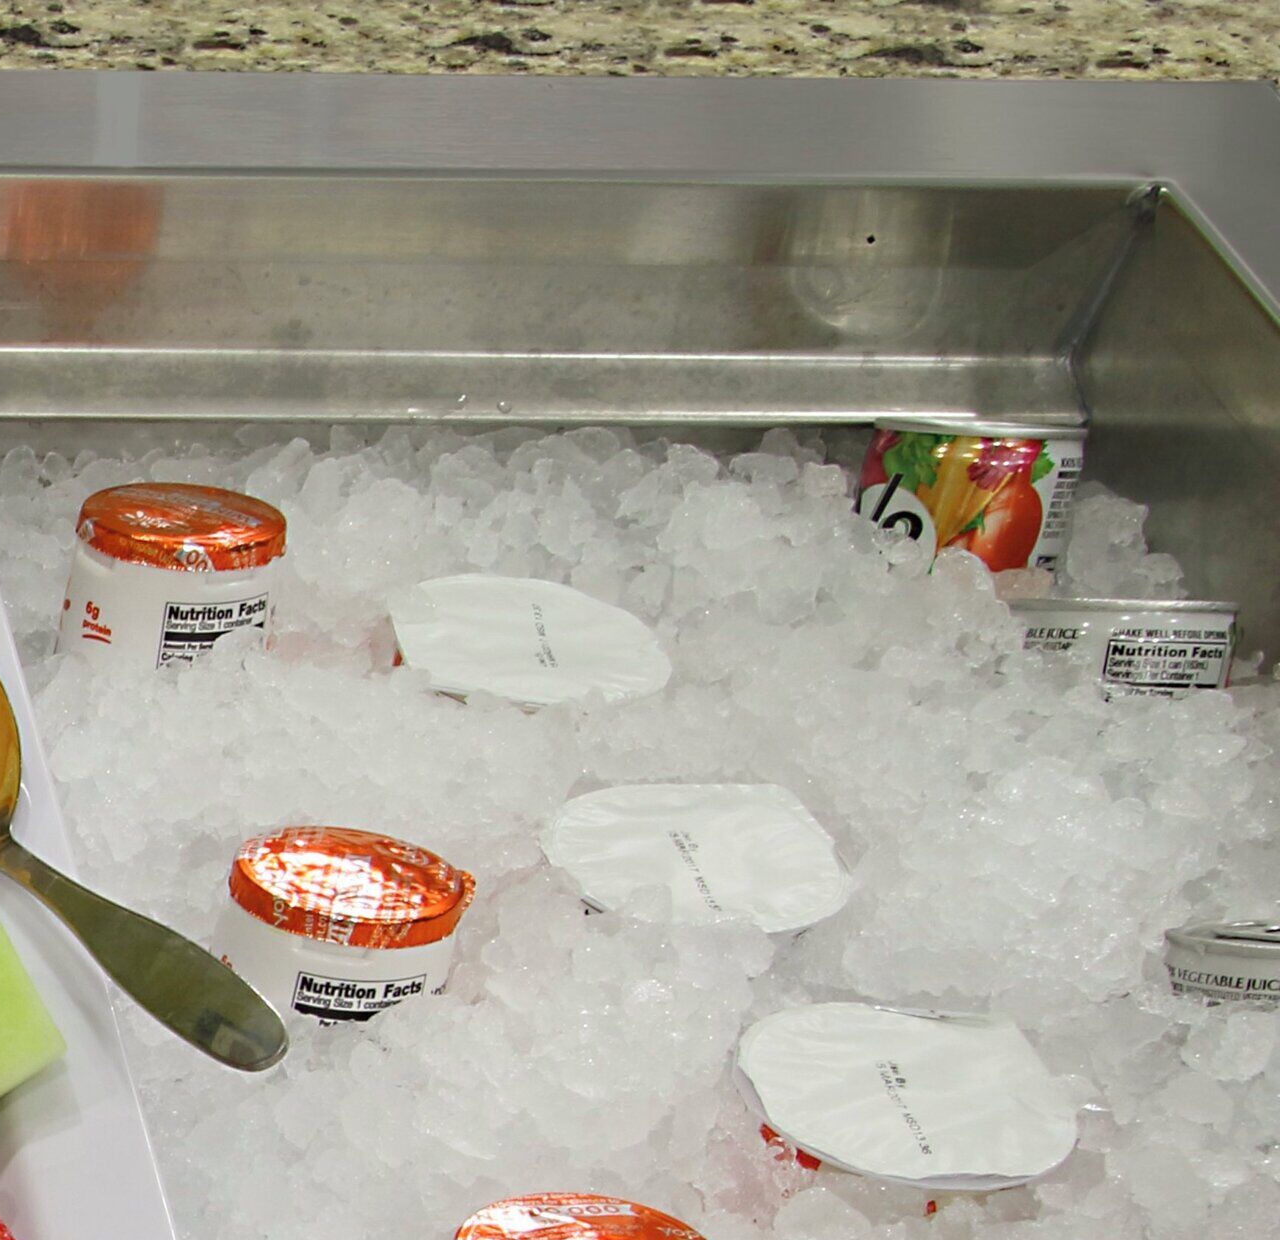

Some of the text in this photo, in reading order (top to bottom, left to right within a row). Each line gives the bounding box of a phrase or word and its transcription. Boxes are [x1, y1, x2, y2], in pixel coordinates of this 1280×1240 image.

[86, 601, 100, 619] 6g
[168, 598, 266, 621] Nutrition Facts
[82, 619, 112, 637] protein
[166, 621, 215, 632] Serving Size
[1112, 644, 1223, 659] Nutrition Facts
[300, 976, 421, 999] Nutrition Facts
[1177, 968, 1244, 989] VEGETABLE
